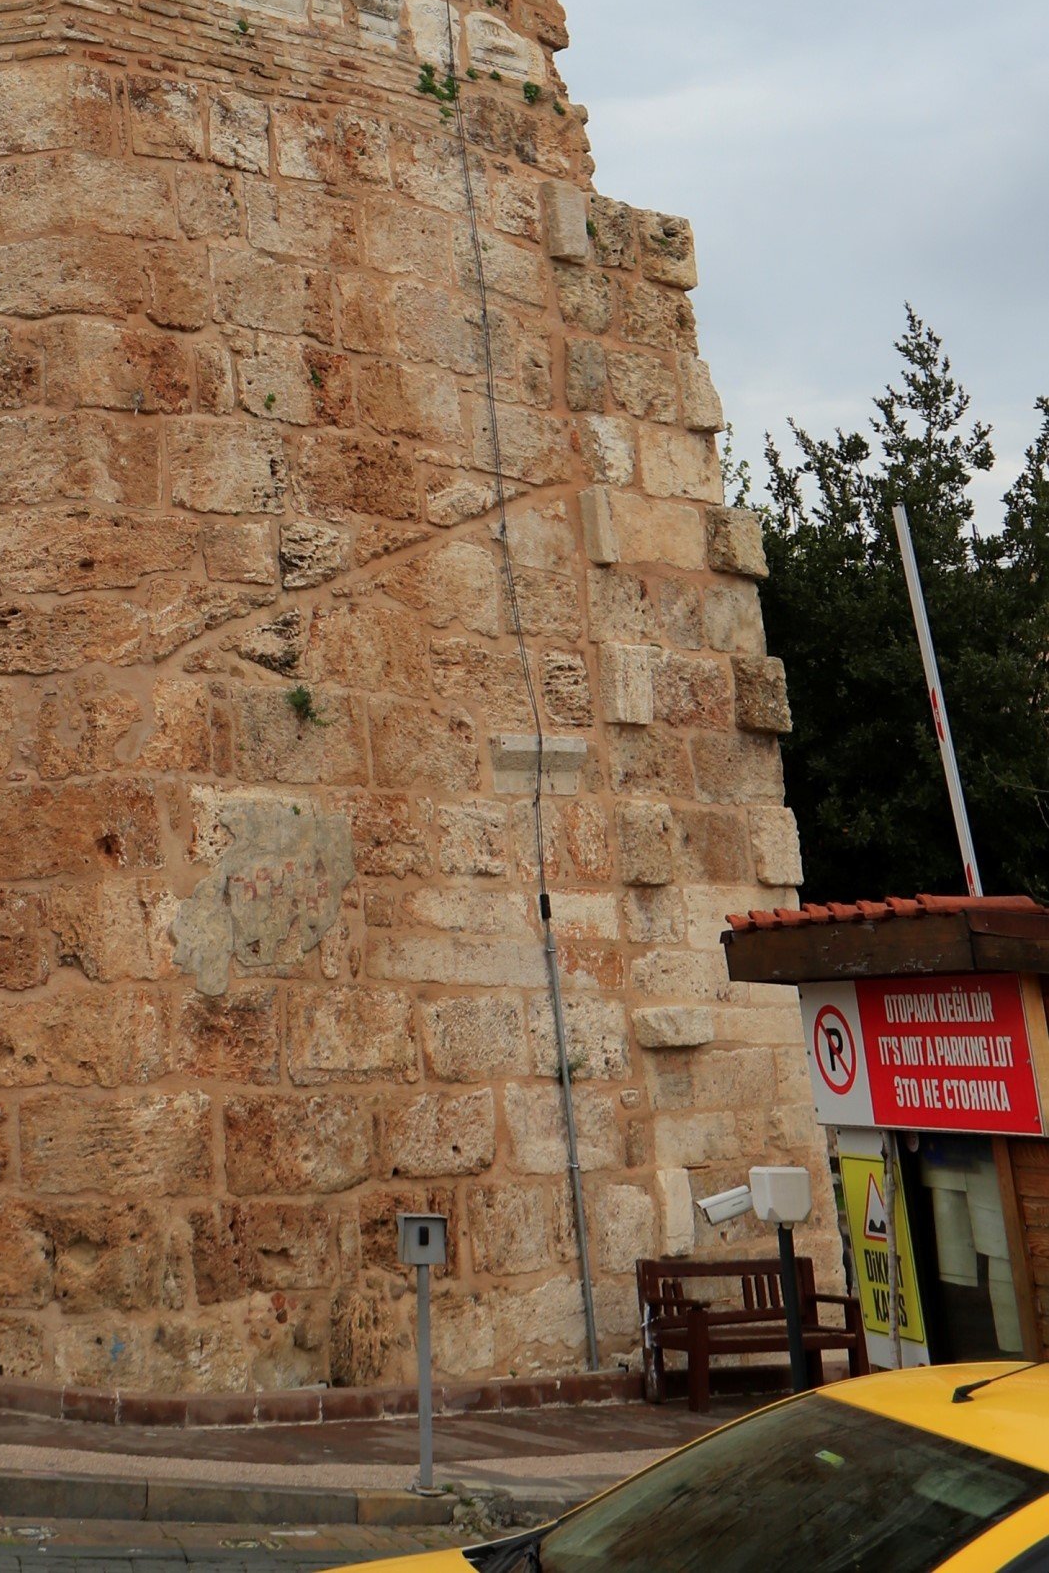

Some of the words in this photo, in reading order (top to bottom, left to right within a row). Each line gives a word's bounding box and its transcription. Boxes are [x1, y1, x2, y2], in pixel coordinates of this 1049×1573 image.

[884, 992, 939, 1024] OTOPARK
[937, 985, 994, 1023] DEĞİLDİR
[901, 1036, 925, 1066] NOT
[926, 1036, 937, 1066] A
[935, 1036, 989, 1067] PARKING
[989, 1036, 1014, 1067] LOT
[894, 1075, 920, 1108] ЭТО
[921, 1078, 942, 1109] НЕ
[943, 1078, 1011, 1112] СТОЯНКА
